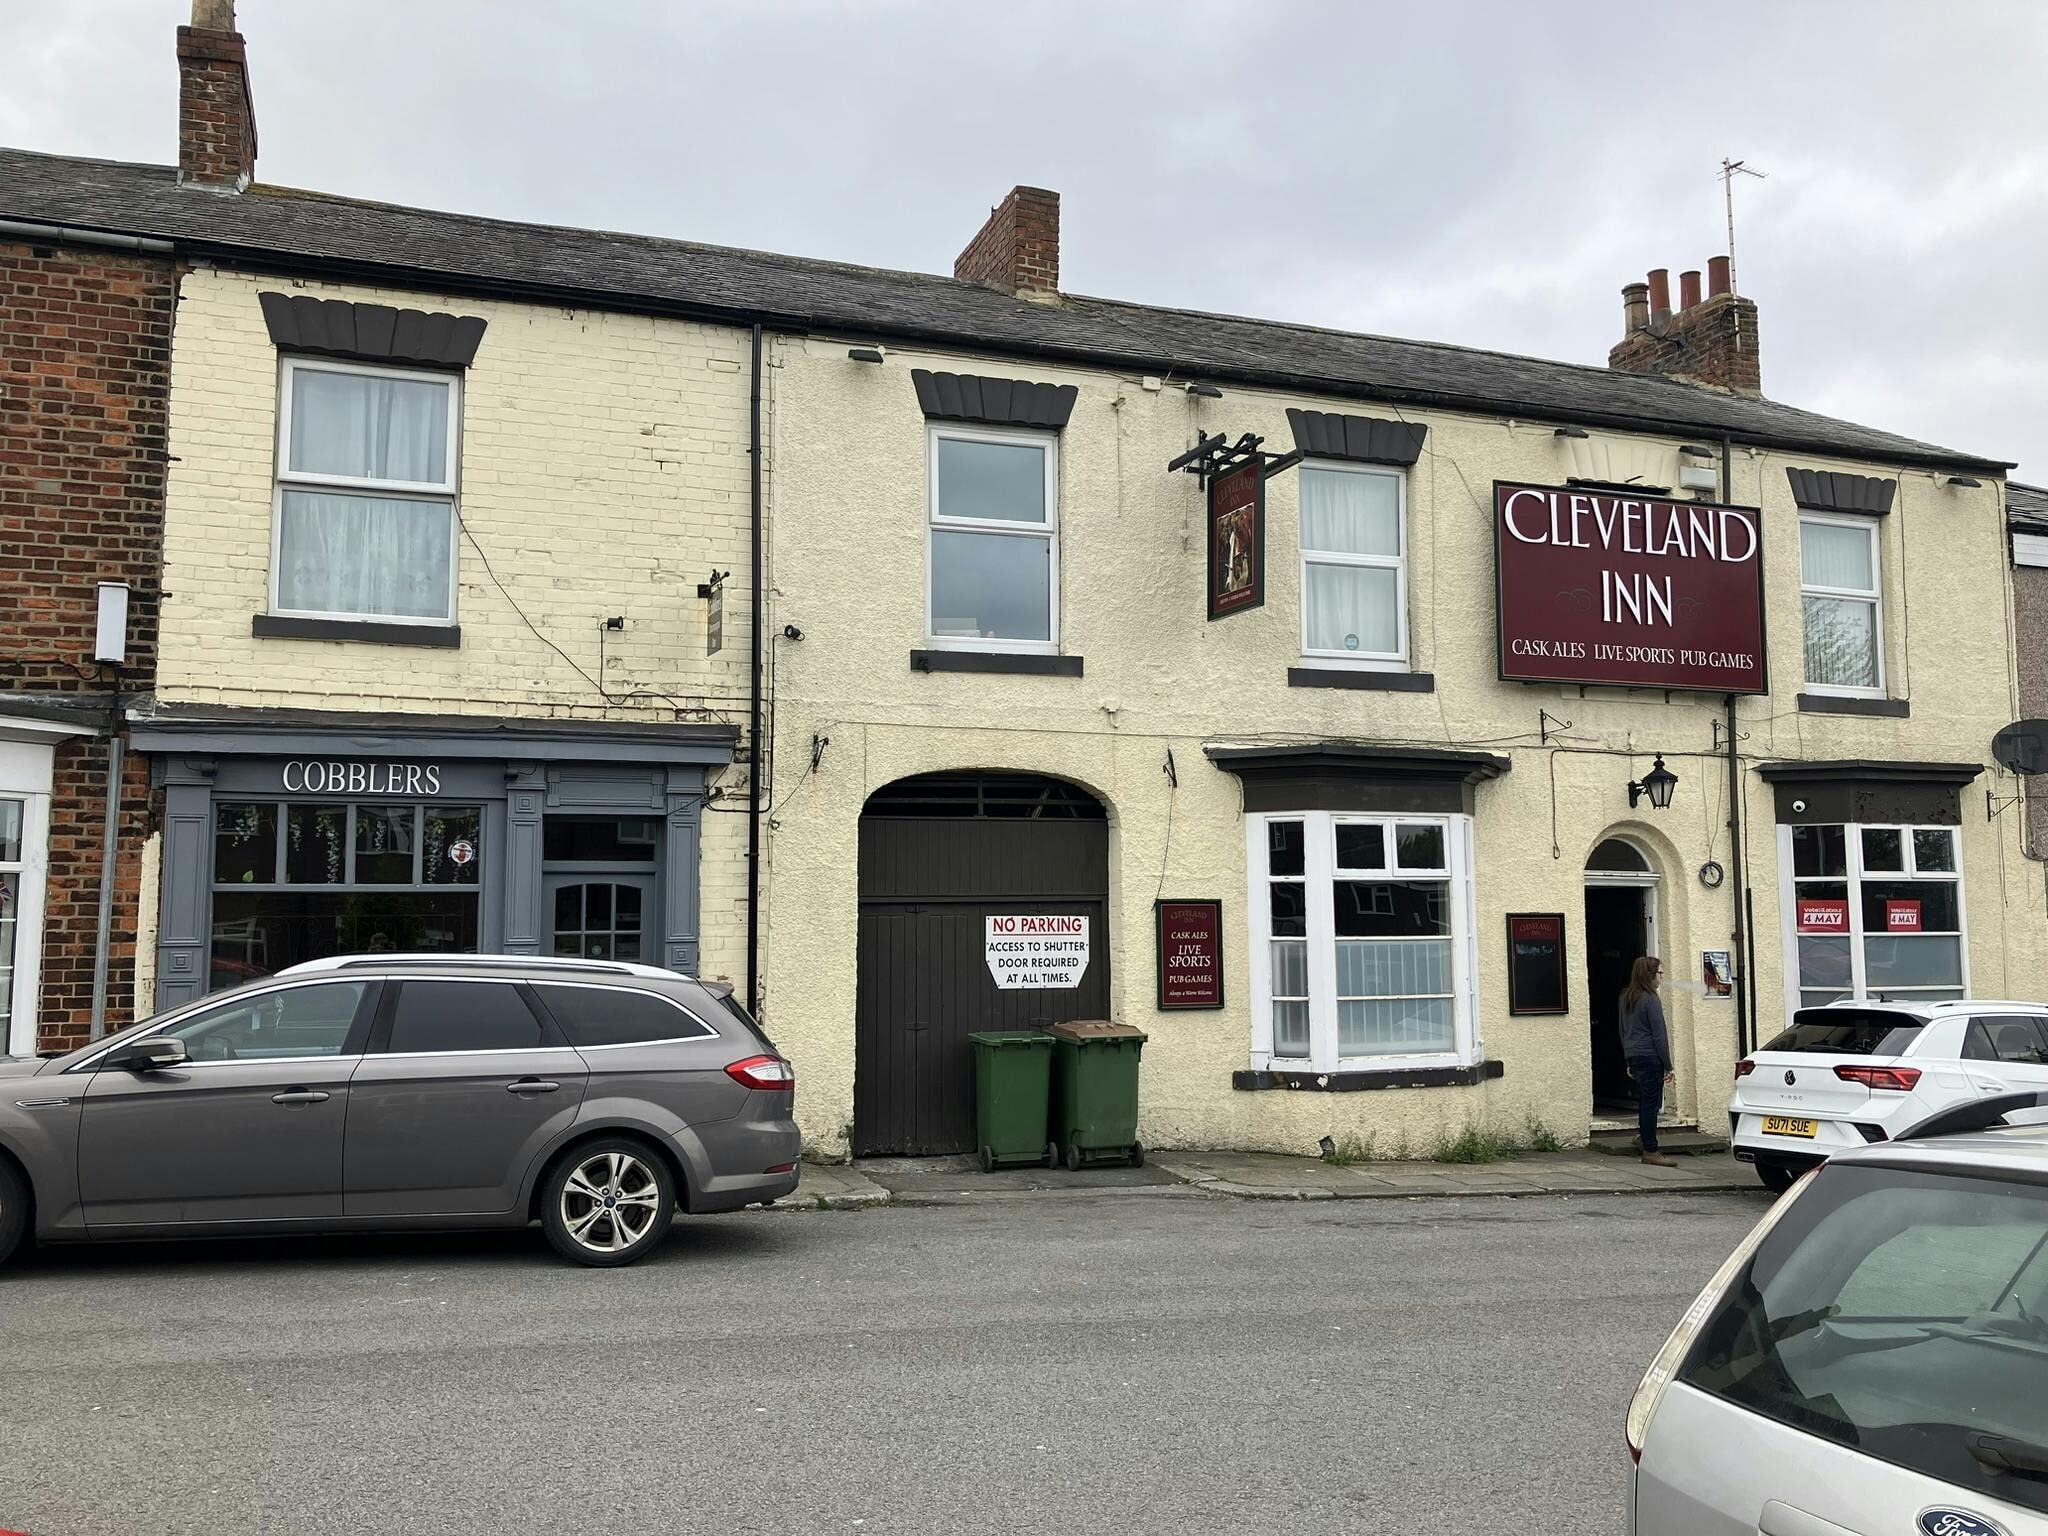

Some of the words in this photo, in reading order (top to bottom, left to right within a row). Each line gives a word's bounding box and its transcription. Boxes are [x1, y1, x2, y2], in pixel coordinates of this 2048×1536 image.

[1505, 491, 1757, 562] CLEVELAND
[1601, 570, 1673, 627] INN
[1511, 638, 1550, 658] CASK
[1552, 641, 1586, 659] ALES
[1594, 643, 1624, 661] LIVE
[1625, 646, 1675, 665] SPORTS
[1680, 649, 1707, 667] PUB
[1708, 652, 1754, 670] GAMES
[283, 761, 441, 795] COBBLERS
[1804, 915, 1811, 923] 4
[1815, 914, 1840, 923] MAY
[1891, 915, 1897, 923] 4
[1898, 914, 1915, 923] MAY
[993, 917, 1016, 933] NO
[1021, 917, 1082, 933] PARKING
[1171, 931, 1191, 940] CASK
[1191, 931, 1208, 940] ALES
[988, 942, 1025, 952] ACCESS
[1028, 942, 1041, 952] TO
[1044, 942, 1086, 952] SHUTTER
[1178, 944, 1202, 956] LIVE
[998, 958, 1029, 968] DOOR
[1031, 957, 1080, 968] REQUIRED
[1169, 955, 1211, 968] SPORTS
[1006, 973, 1018, 983] AT
[1021, 973, 1039, 983] ALL
[1042, 972, 1072, 983] TIMES.
[1169, 974, 1185, 984] PUB
[1185, 974, 1212, 984] GAMES
[1768, 1118, 1789, 1130] SU71
[1790, 1120, 1811, 1132] SUE
